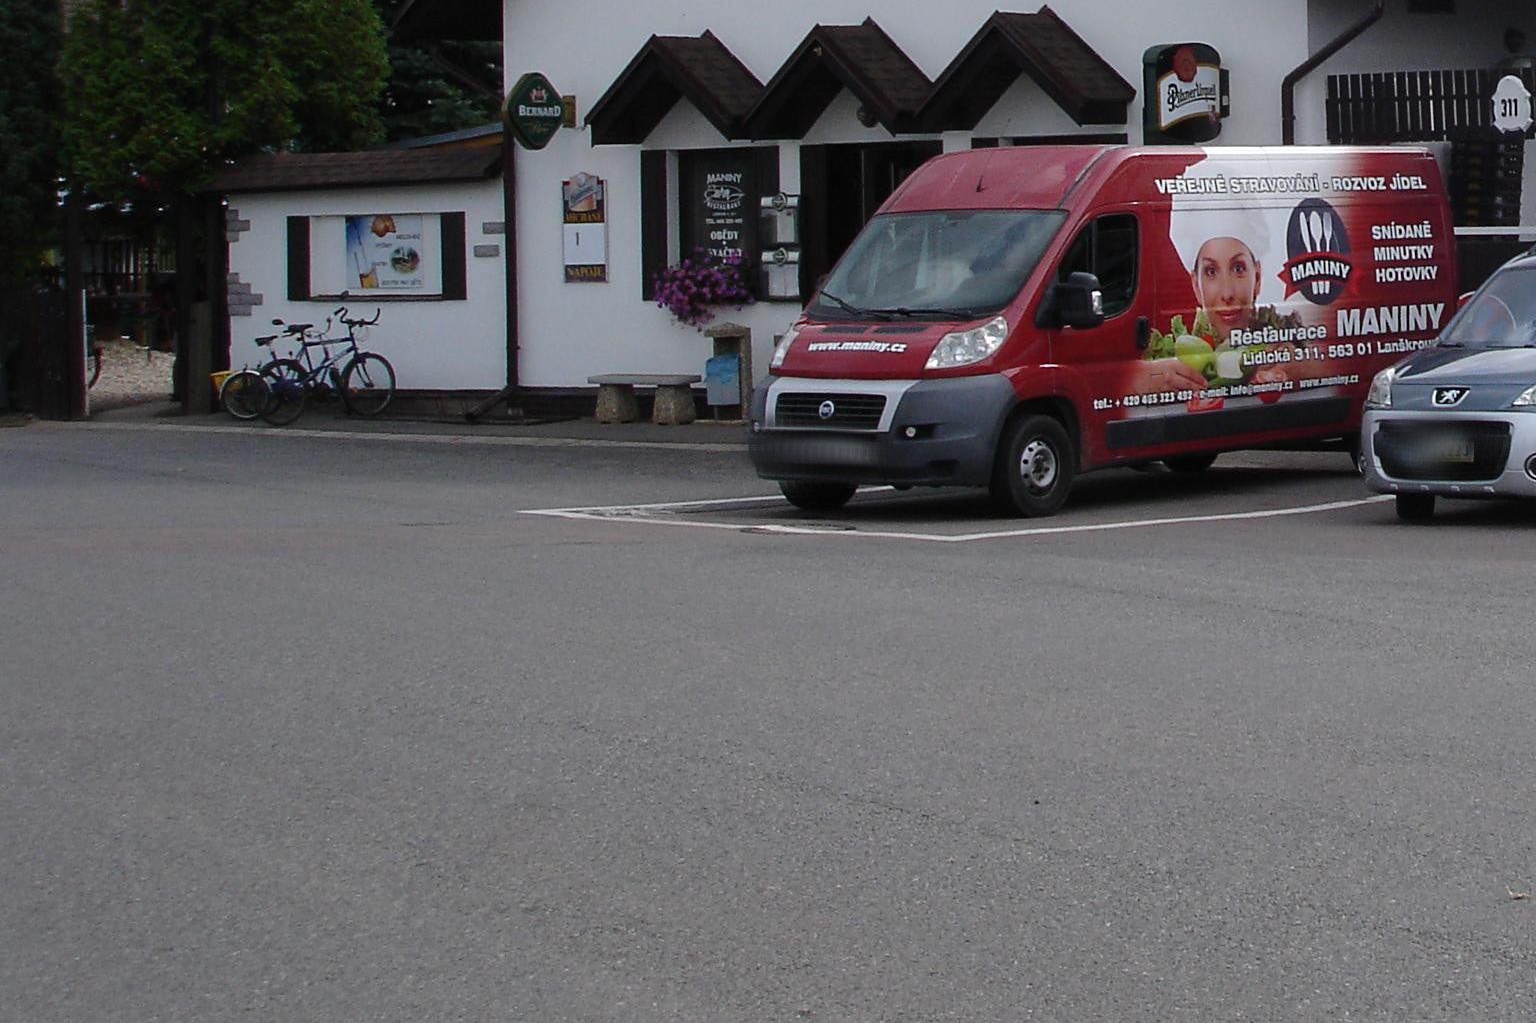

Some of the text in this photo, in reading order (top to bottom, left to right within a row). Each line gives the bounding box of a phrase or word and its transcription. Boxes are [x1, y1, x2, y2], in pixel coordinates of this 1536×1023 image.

[1501, 98, 1518, 117] 311
[706, 173, 742, 184] MANINY
[1154, 175, 1227, 195] VEŘEJNÉ
[1230, 174, 1320, 194] STRAVOVÁNÍ
[1332, 176, 1386, 191] ROZVOZ
[1389, 172, 1427, 190] JÍDEL
[1371, 220, 1432, 240] SNÍDANĚ
[1373, 245, 1434, 261] MINUTKY
[1290, 260, 1350, 282] MANINY
[1375, 266, 1438, 283] HOTOVKY
[1229, 303, 1446, 347] Restaurace MANINY
[808, 340, 907, 353] www.maniny.cz
[1243, 337, 1436, 366] Lidická 311, 563 01 Lanškrou
[1299, 374, 1359, 389] www.maniny.cz
